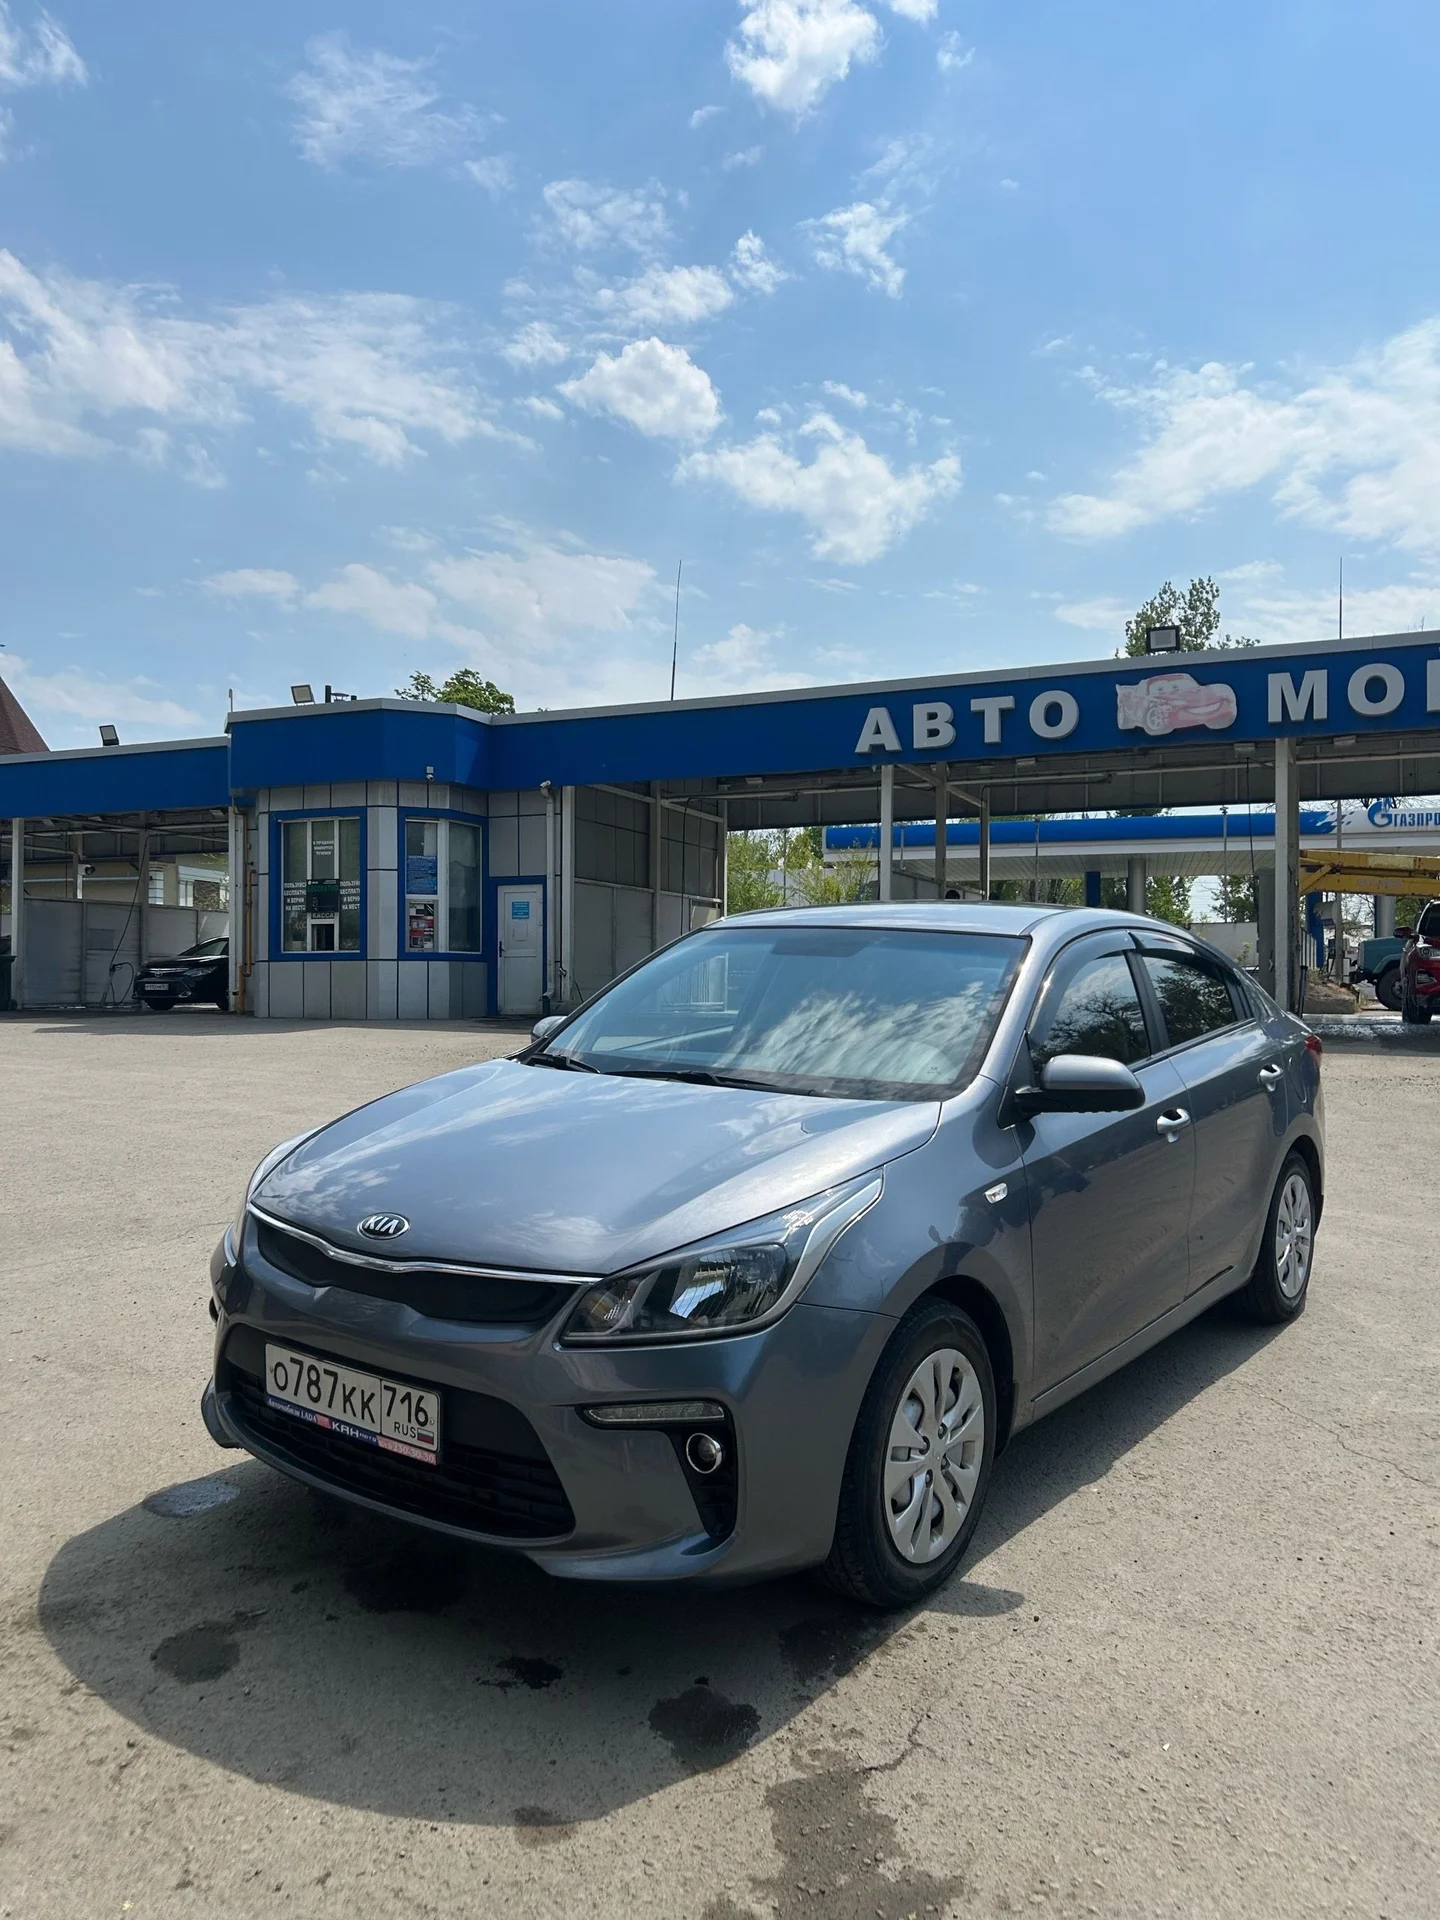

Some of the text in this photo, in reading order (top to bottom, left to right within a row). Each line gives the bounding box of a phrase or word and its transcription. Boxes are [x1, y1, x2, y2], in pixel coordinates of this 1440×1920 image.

[854, 656, 1440, 754] АВТО МО
[1393, 812, 1440, 827] ГАЗПРО
[364, 1215, 399, 1234] KIA
[300, 1410, 317, 1423] LADA
[393, 1421, 417, 1439] RUS
